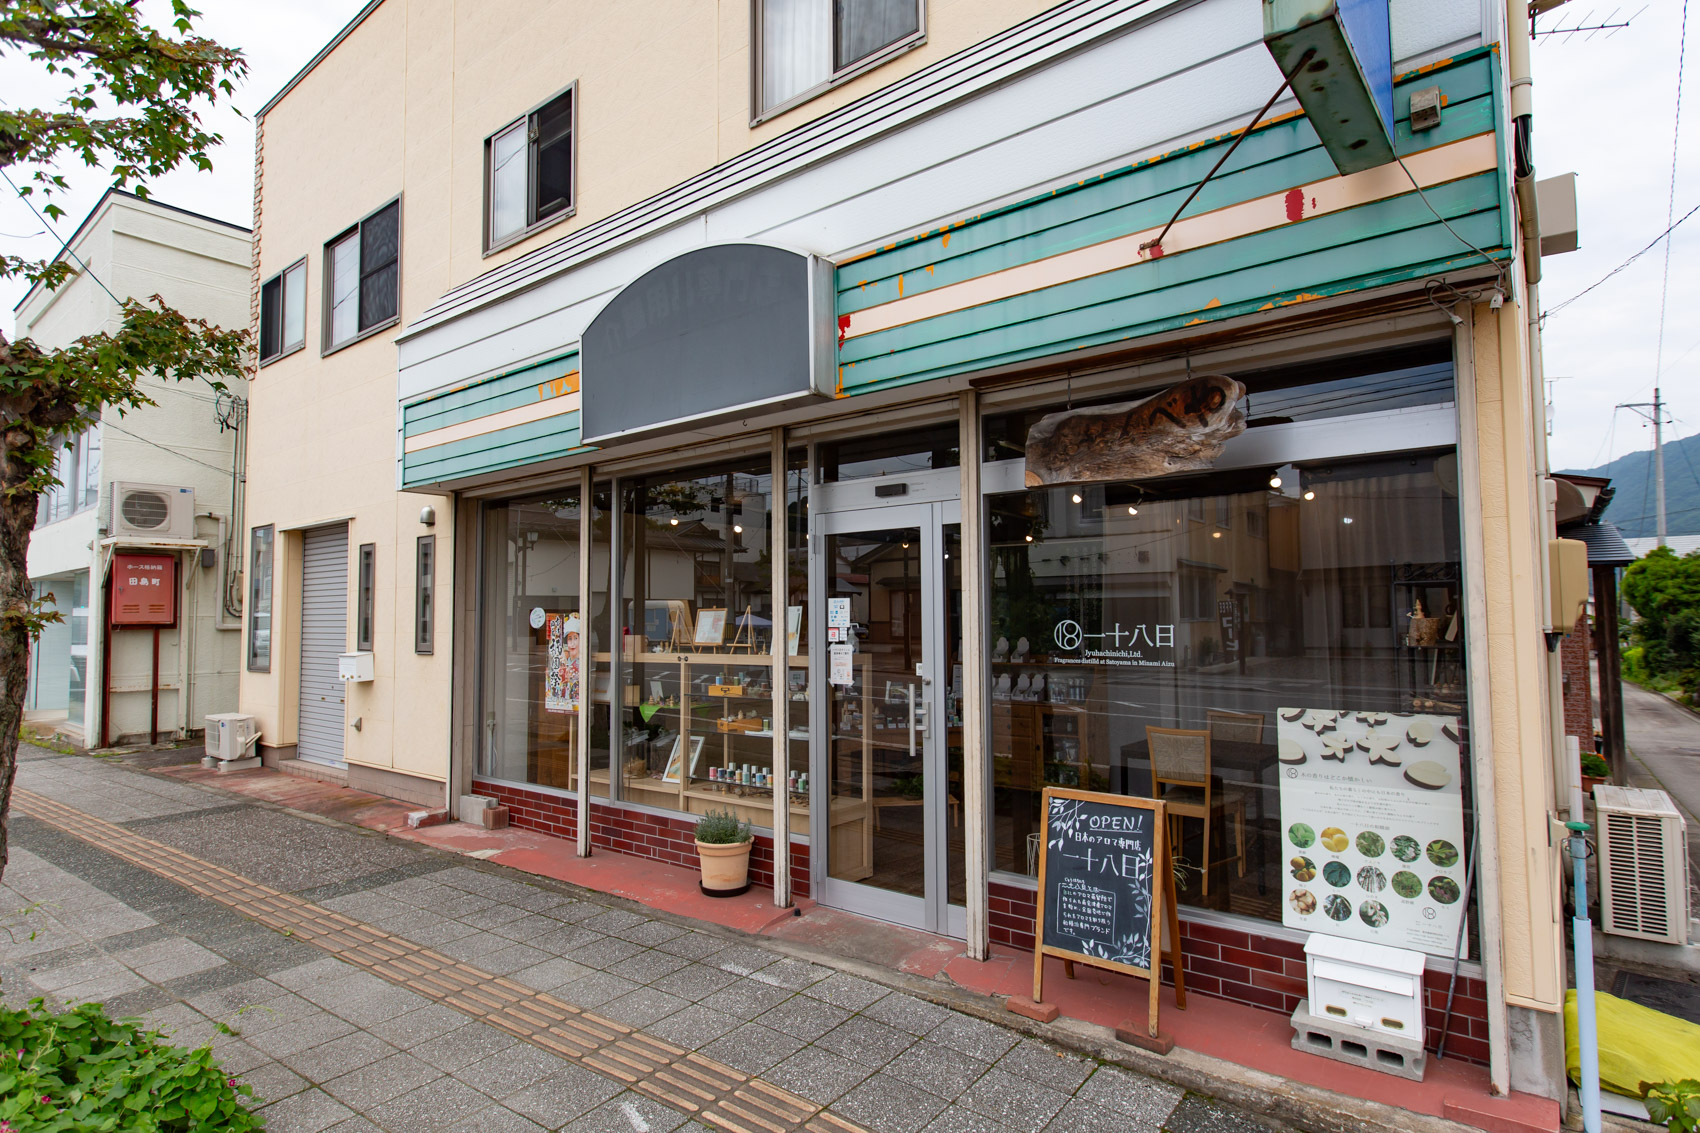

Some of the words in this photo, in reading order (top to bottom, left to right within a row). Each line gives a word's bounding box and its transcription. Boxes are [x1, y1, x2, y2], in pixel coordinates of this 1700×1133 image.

[128, 577, 161, 586] 田島町
[1083, 622, 1175, 648] 一十八日
[1106, 659, 1131, 667] Satoyama
[1089, 815, 1143, 831] OPEN!
[1075, 832, 1142, 851] 日本のアロマ専門店
[1062, 848, 1140, 879] 一十八日
